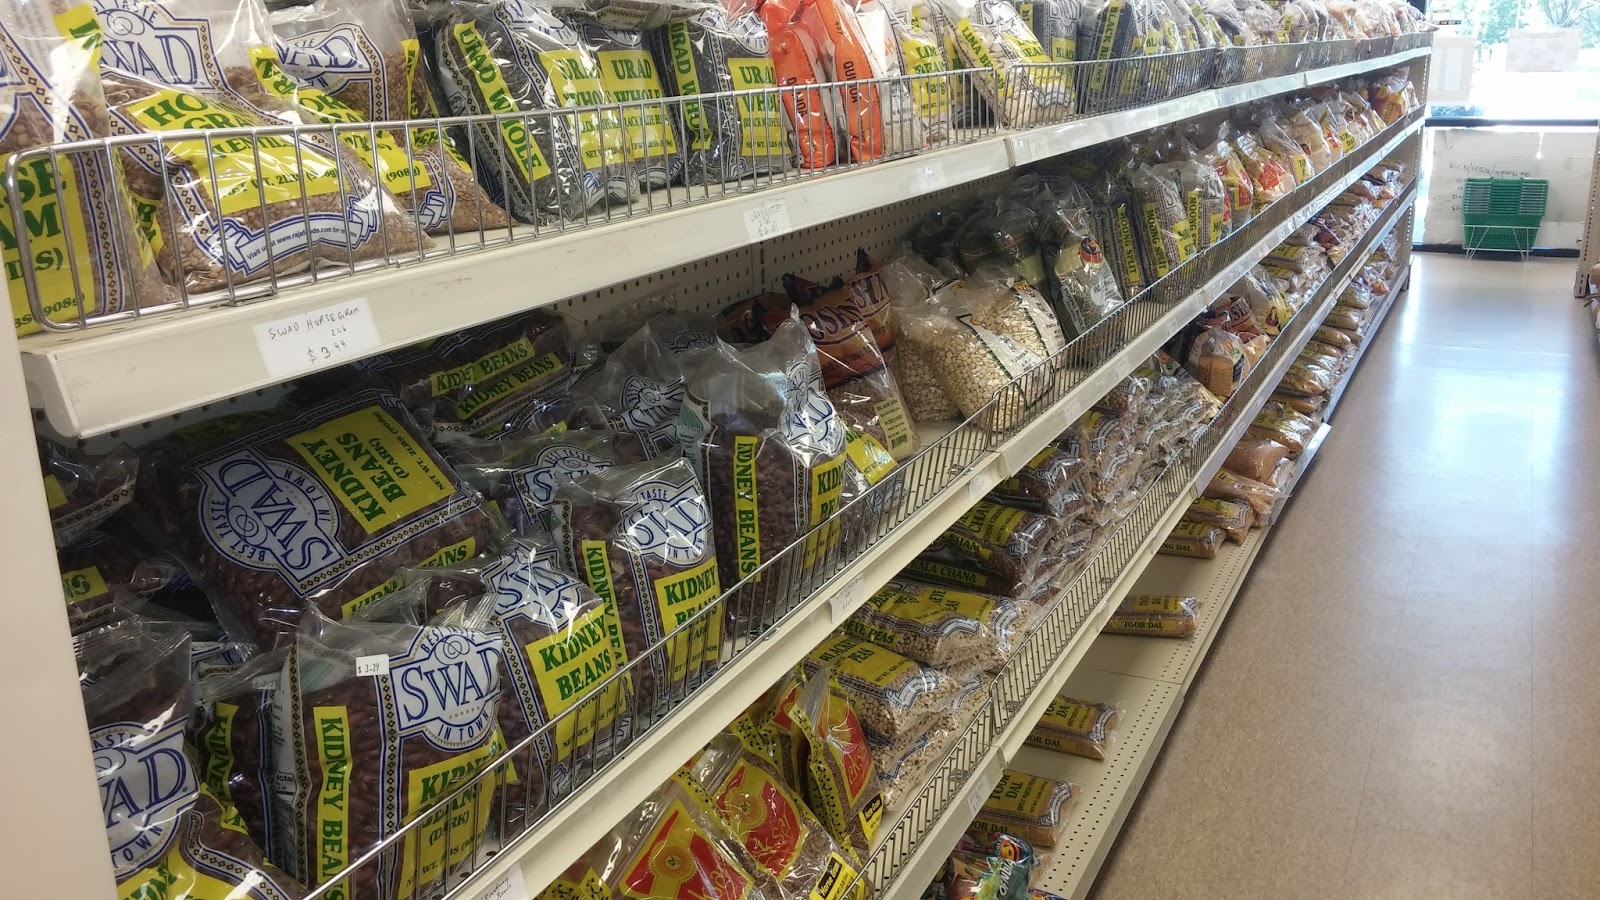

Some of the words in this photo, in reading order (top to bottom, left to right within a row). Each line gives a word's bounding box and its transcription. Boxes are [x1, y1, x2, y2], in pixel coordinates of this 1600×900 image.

[672, 22, 692, 75] URAD
[915, 45, 941, 60] LIM
[962, 27, 980, 56] LIMA
[611, 58, 652, 80] URAD
[464, 26, 497, 84] URAD
[489, 91, 544, 172] WHOLE
[1189, 196, 1198, 231] MOONG
[1118, 211, 1132, 248] MOONG
[1126, 248, 1137, 274] SPLIT
[480, 341, 530, 377] BEANS
[458, 374, 513, 418] KIDNEY
[515, 354, 557, 385] BEANS
[335, 431, 408, 503] BEANS
[368, 437, 410, 479] (DARK)
[395, 436, 416, 458] 2LBS
[415, 458, 430, 476] WT.
[283, 469, 324, 502] TOWN
[301, 438, 387, 523] KIDNEY
[430, 474, 447, 491] NET
[211, 499, 234, 539] TASTE
[218, 458, 333, 571] SWAD
[316, 508, 331, 523] IN
[230, 541, 266, 562] BEST
[420, 544, 468, 569] EANS
[738, 508, 758, 575] BEANS
[586, 547, 615, 618] KIDNEY
[664, 565, 717, 606] KIDNEY
[941, 565, 977, 584] CHANA
[538, 613, 606, 672] KIDNEY
[400, 647, 501, 722] SWAD
[555, 648, 612, 701] BEANS
[437, 724, 451, 742] IN
[458, 710, 490, 742] TOWN
[208, 715, 230, 801] KIDNE
[321, 717, 346, 811] KIDNEY
[1005, 782, 1024, 800] DAL
